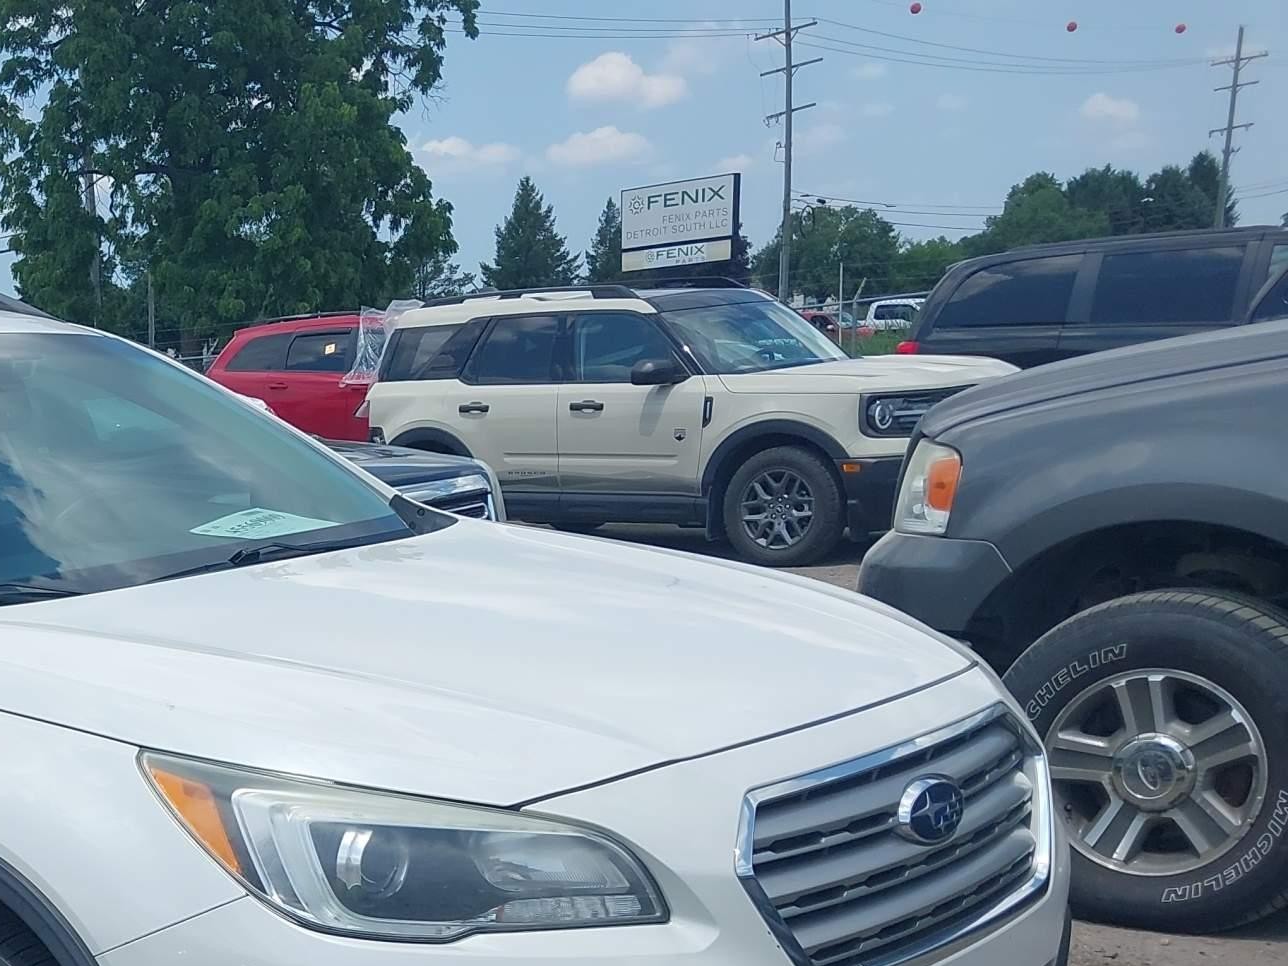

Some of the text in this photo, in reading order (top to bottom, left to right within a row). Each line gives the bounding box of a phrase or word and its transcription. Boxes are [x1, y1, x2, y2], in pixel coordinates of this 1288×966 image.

[647, 185, 726, 211] FENIX
[662, 207, 729, 225] FENIX PARTS
[626, 218, 729, 240] DETROIT SOUTH LLC
[655, 244, 705, 261] FENIX
[1025, 643, 1128, 722] CHELIN
